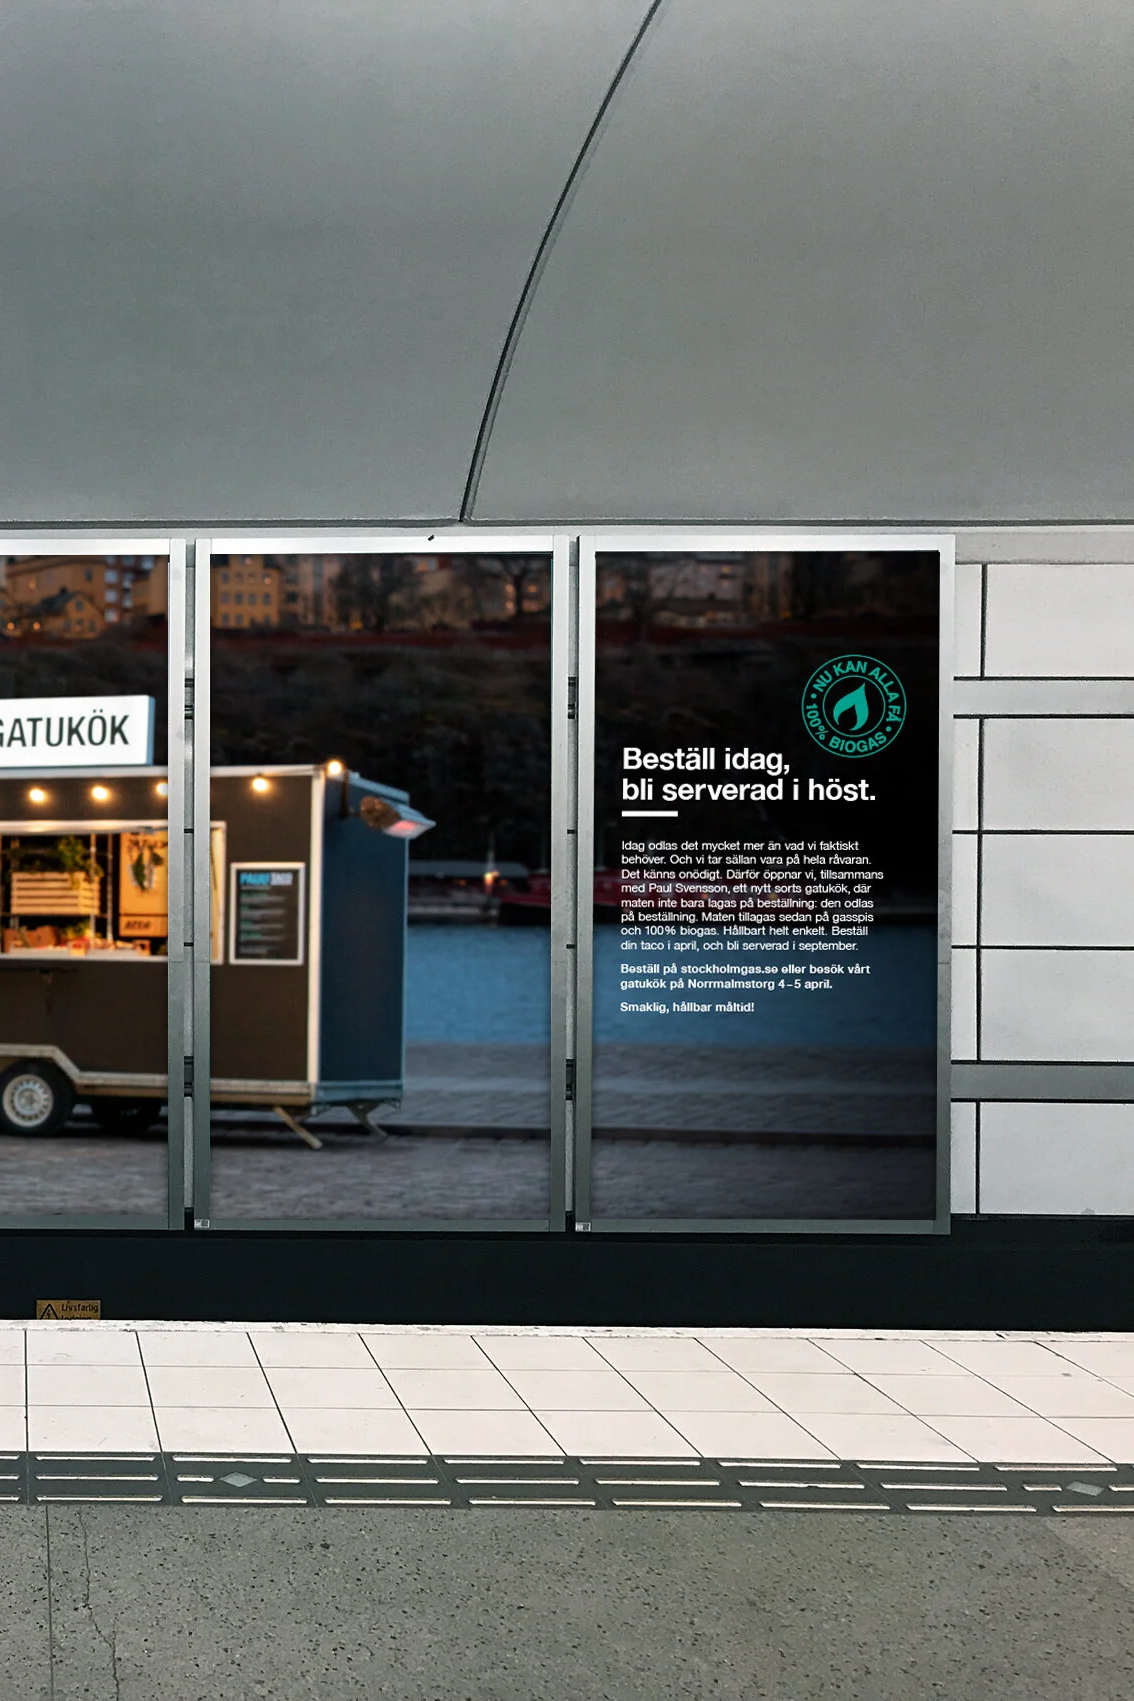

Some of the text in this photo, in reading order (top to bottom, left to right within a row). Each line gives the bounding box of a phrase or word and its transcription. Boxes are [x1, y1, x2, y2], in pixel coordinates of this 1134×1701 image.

[812, 660, 902, 723] NU KAN ALLA FÅ
[806, 703, 887, 753] 100% BIOGAS
[623, 747, 790, 777] Beställ idag,
[622, 777, 876, 802] bli serverad i höst.
[622, 840, 859, 853] Idag odlas det mycket mer än vad vi faktiskt
[621, 853, 872, 866] behöver. Och vi tar sällan vara på hela råvaran.
[621, 869, 884, 882] Det känns onödigt. Därför öppnar vi, tillsammans
[621, 882, 872, 896] med Paul Svensson, ett nytt sorts gatukök, där
[621, 897, 874, 911] maten inte bara lagas på beställning: den odlas
[621, 910, 874, 924] på beställning. Maten tillagas sedan på gasspis
[620, 924, 868, 938] och 100% biogas. Hållbart helt enkelt. Beställ
[620, 940, 637, 950] din
[640, 940, 665, 951] taco
[673, 940, 700, 952] april,
[703, 941, 724, 951] och
[726, 940, 739, 951] bli
[742, 940, 790, 951] serverad
[798, 941, 859, 953] september.
[620, 962, 871, 976] Beställ på stockholmgas.se eller besök vårt
[620, 978, 667, 991] gatukök
[669, 977, 685, 991] på
[687, 978, 775, 991] Norrmalmstorg
[804, 979, 833, 991] april.
[620, 1001, 755, 1014] Smaklig, hållbar måltid!
